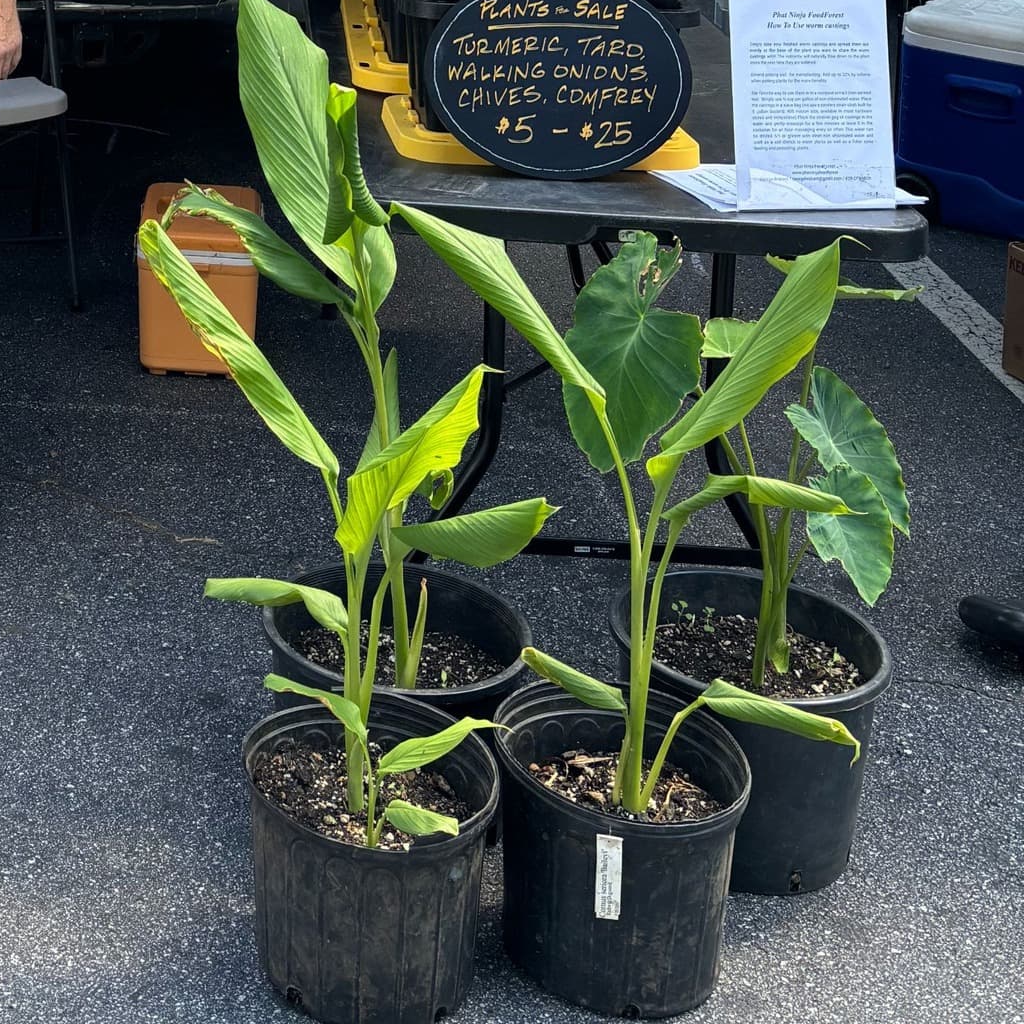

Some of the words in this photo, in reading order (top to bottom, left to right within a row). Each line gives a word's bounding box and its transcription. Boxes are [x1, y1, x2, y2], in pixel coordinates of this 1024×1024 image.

[480, 0, 550, 20] PLANTS
[574, 0, 628, 20] SALE
[772, 11, 787, 19] Phat
[788, 11, 806, 20] Ninja
[808, 10, 845, 19] FoodForest
[825, 22, 851, 30] castings
[453, 33, 569, 56] TURMERIC,
[578, 36, 645, 61] TARO,
[448, 62, 546, 83] WALKING
[556, 84, 658, 115] COMFREY
[495, 114, 536, 144] $5
[579, 121, 632, 149] $25
